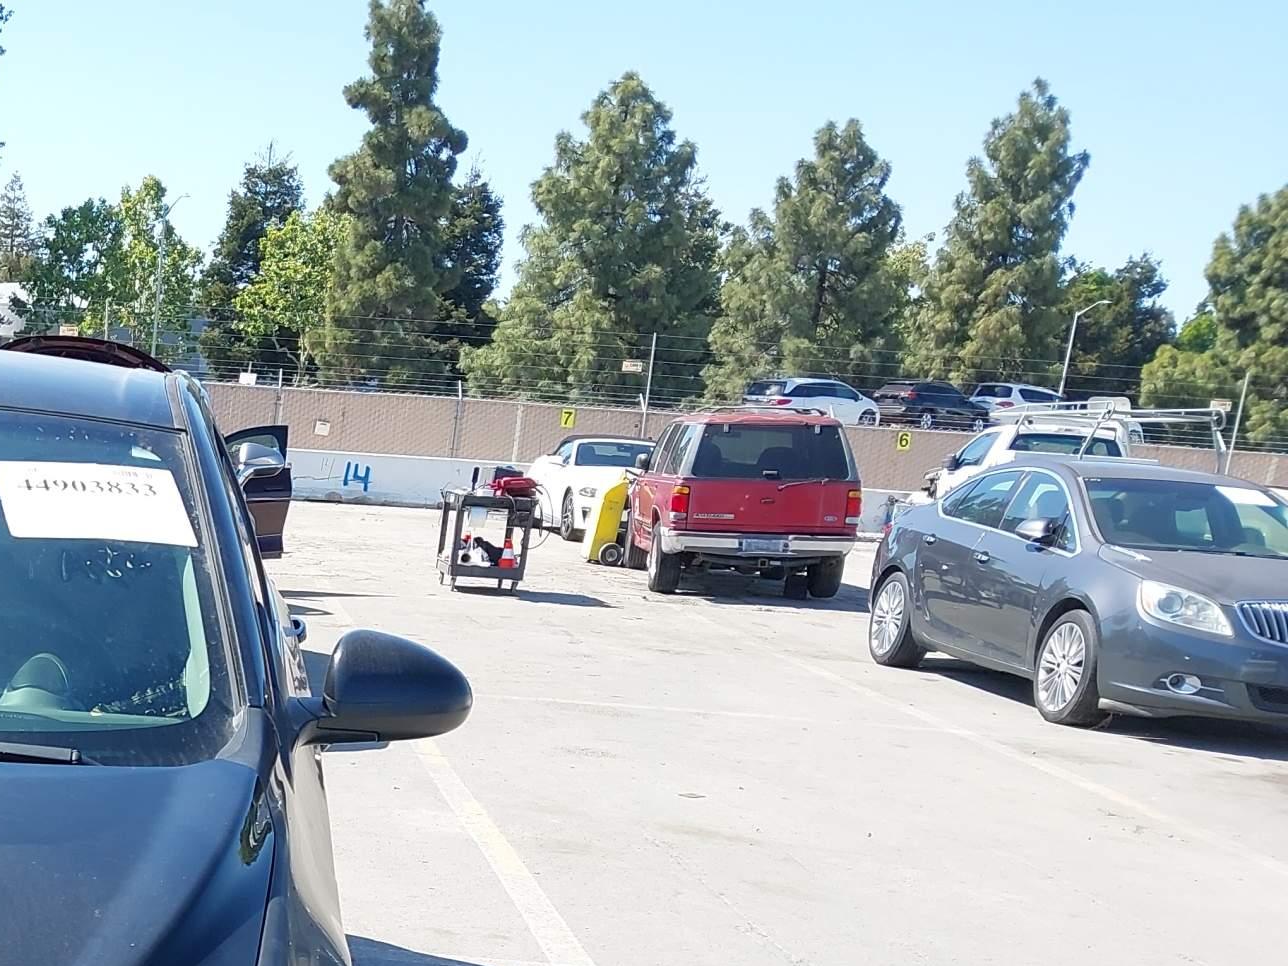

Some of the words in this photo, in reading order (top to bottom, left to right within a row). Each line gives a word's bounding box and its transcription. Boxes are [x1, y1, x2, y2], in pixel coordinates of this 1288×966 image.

[563, 411, 573, 425] 7
[899, 433, 909, 448] 6
[343, 461, 371, 492] 14
[16, 478, 158, 497] 44903833
